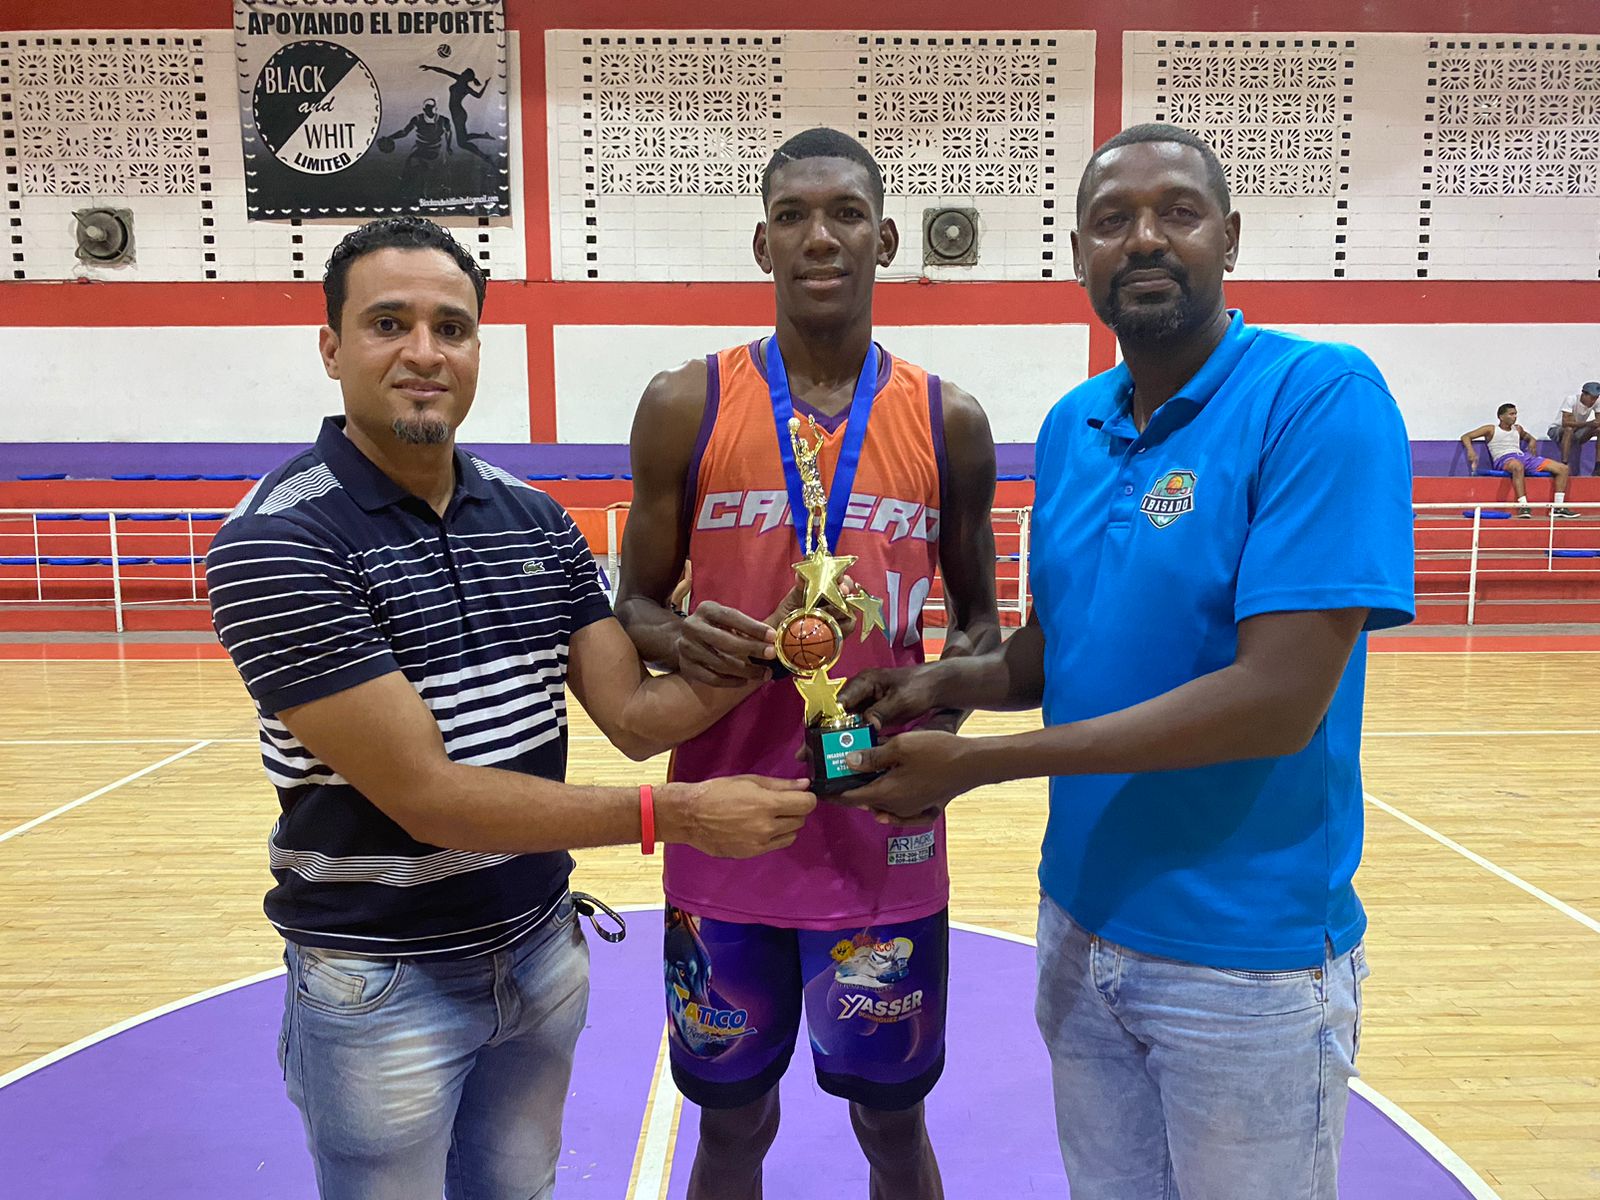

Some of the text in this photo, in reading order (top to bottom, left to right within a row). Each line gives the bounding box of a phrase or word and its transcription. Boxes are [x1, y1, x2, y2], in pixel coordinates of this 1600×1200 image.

[248, 11, 495, 36] APOYANDO EL DEPORTE
[264, 65, 327, 94] BLACK
[298, 96, 336, 114] and
[304, 123, 355, 150] WHIT
[294, 152, 352, 172] LIMITED
[696, 490, 940, 543] CAERO
[1141, 498, 1189, 512] IBASADO
[837, 989, 923, 1020] YASSER
